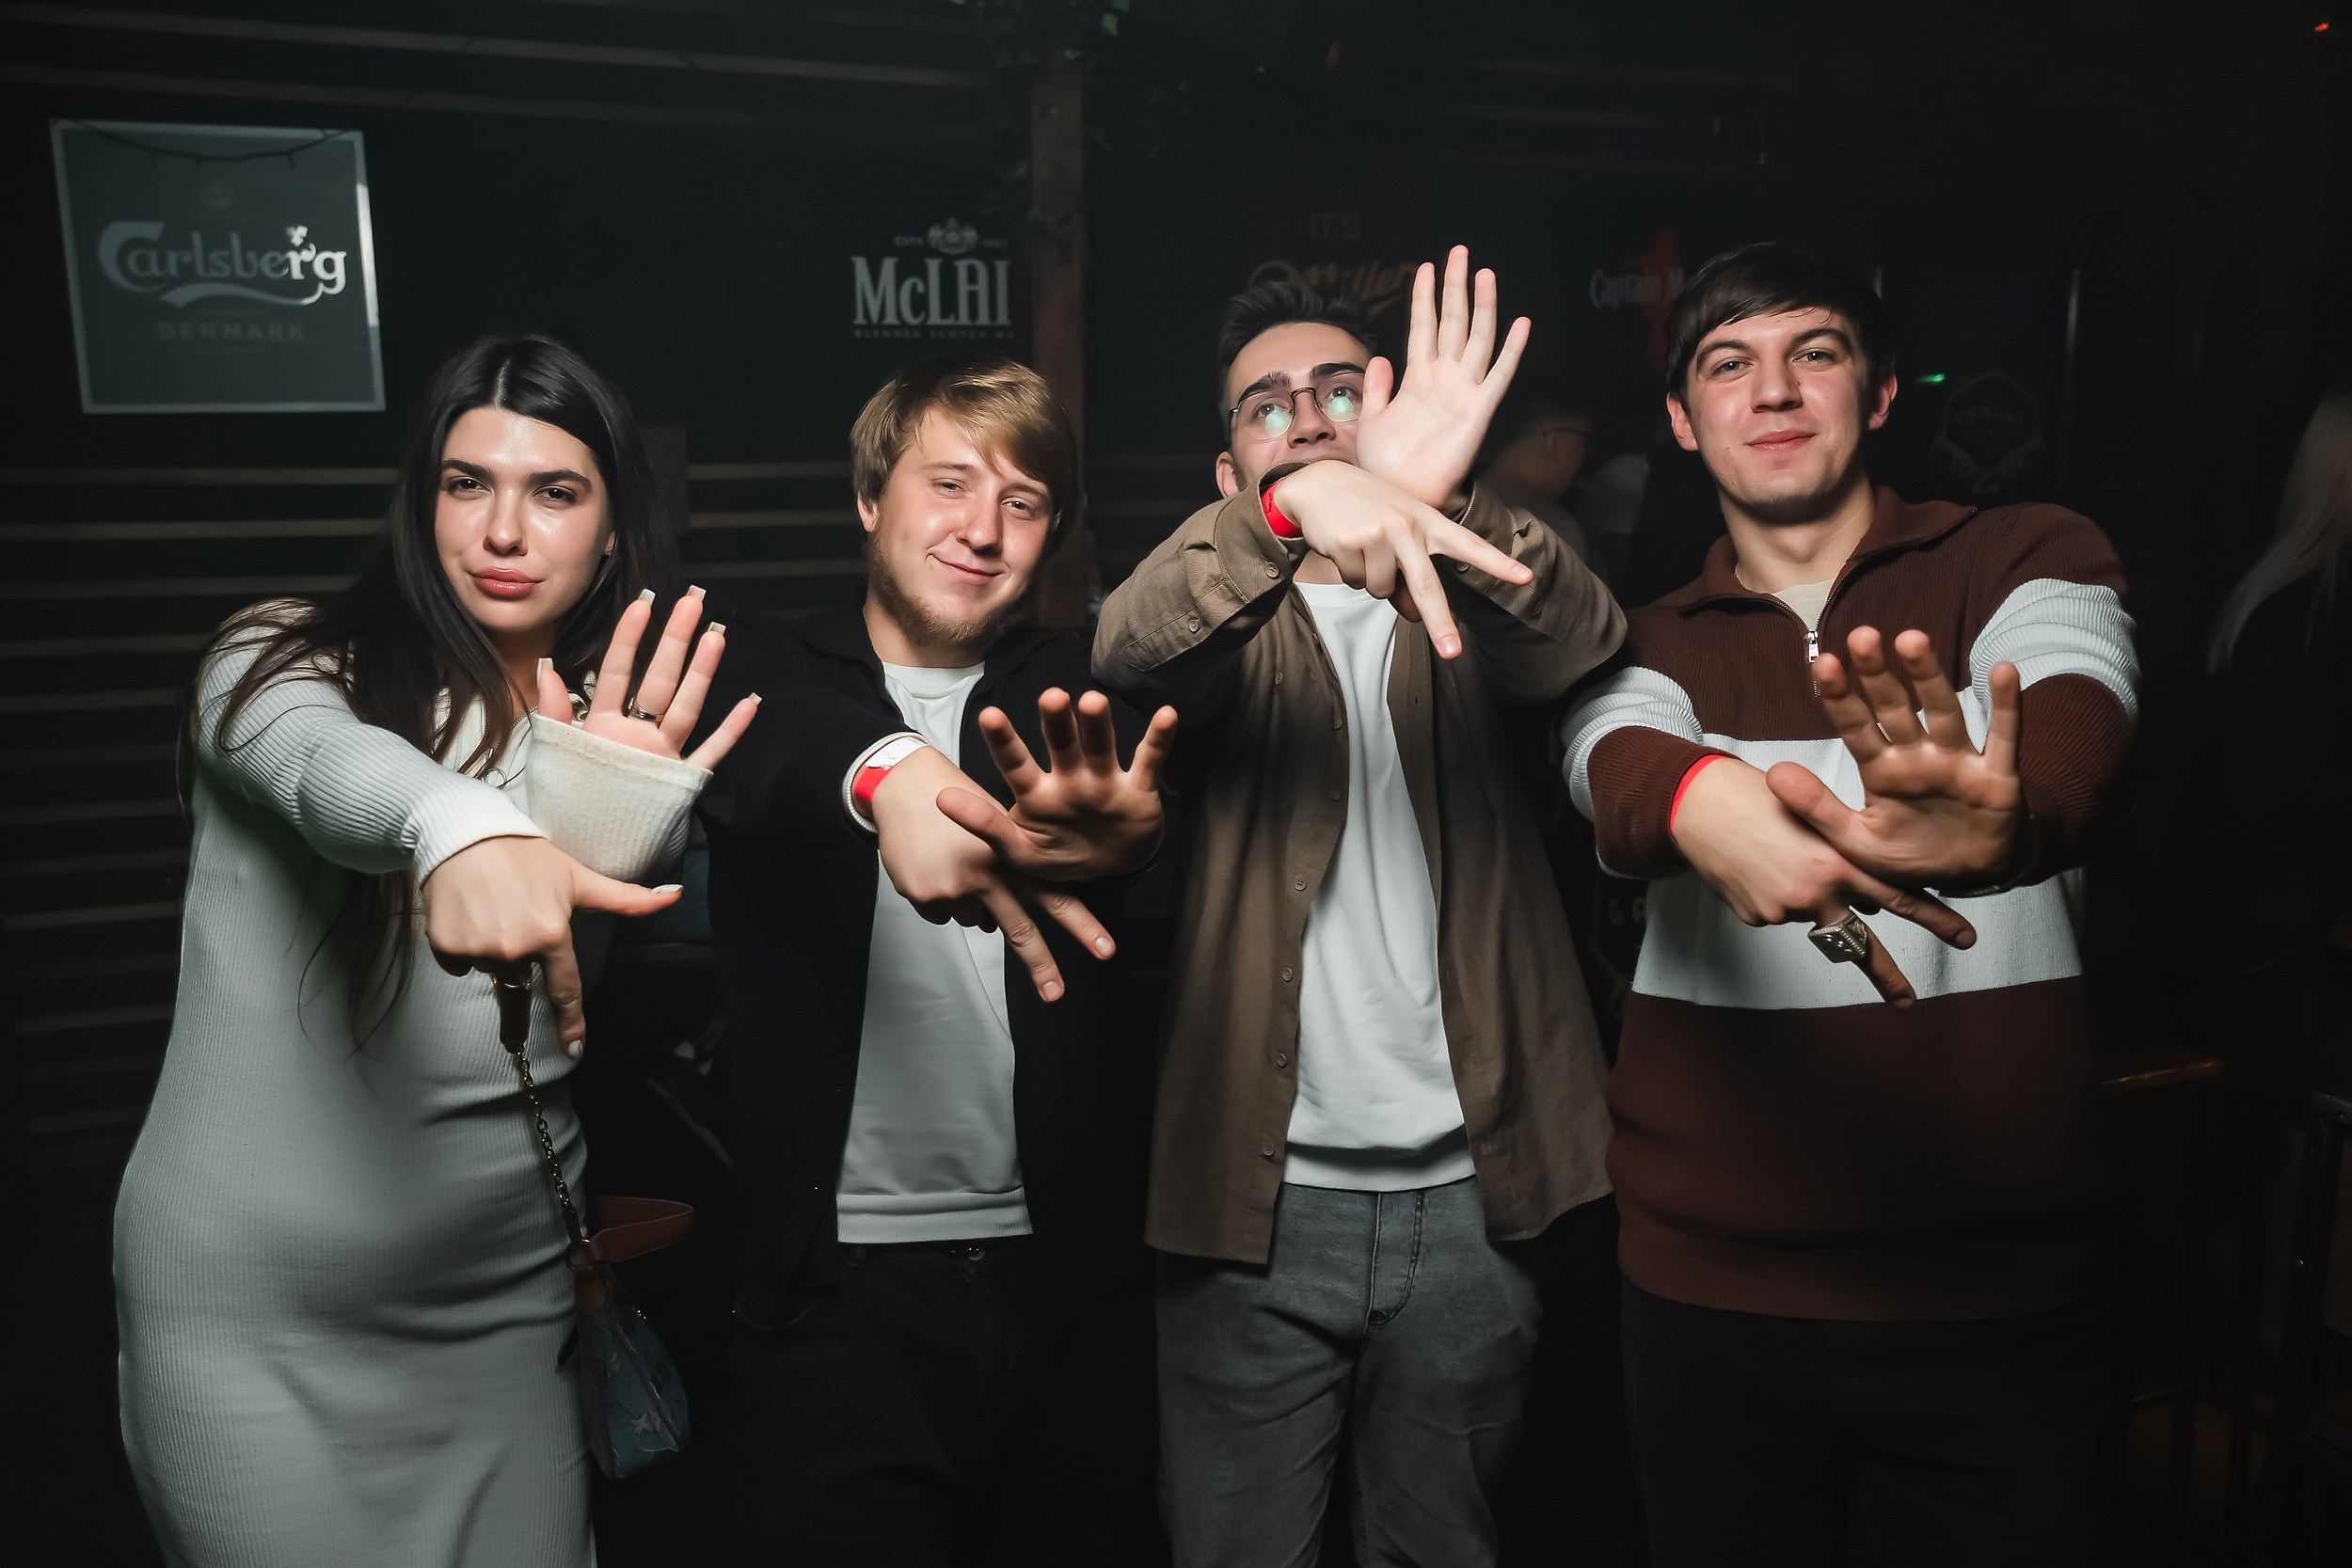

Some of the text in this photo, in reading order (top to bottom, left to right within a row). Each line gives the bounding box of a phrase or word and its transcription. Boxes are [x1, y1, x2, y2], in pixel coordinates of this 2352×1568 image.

[98, 221, 347, 307] Carlsberg
[1589, 269, 1661, 311] Captain
[157, 321, 305, 341] DENMARK
[853, 328, 922, 340] BLENDED
